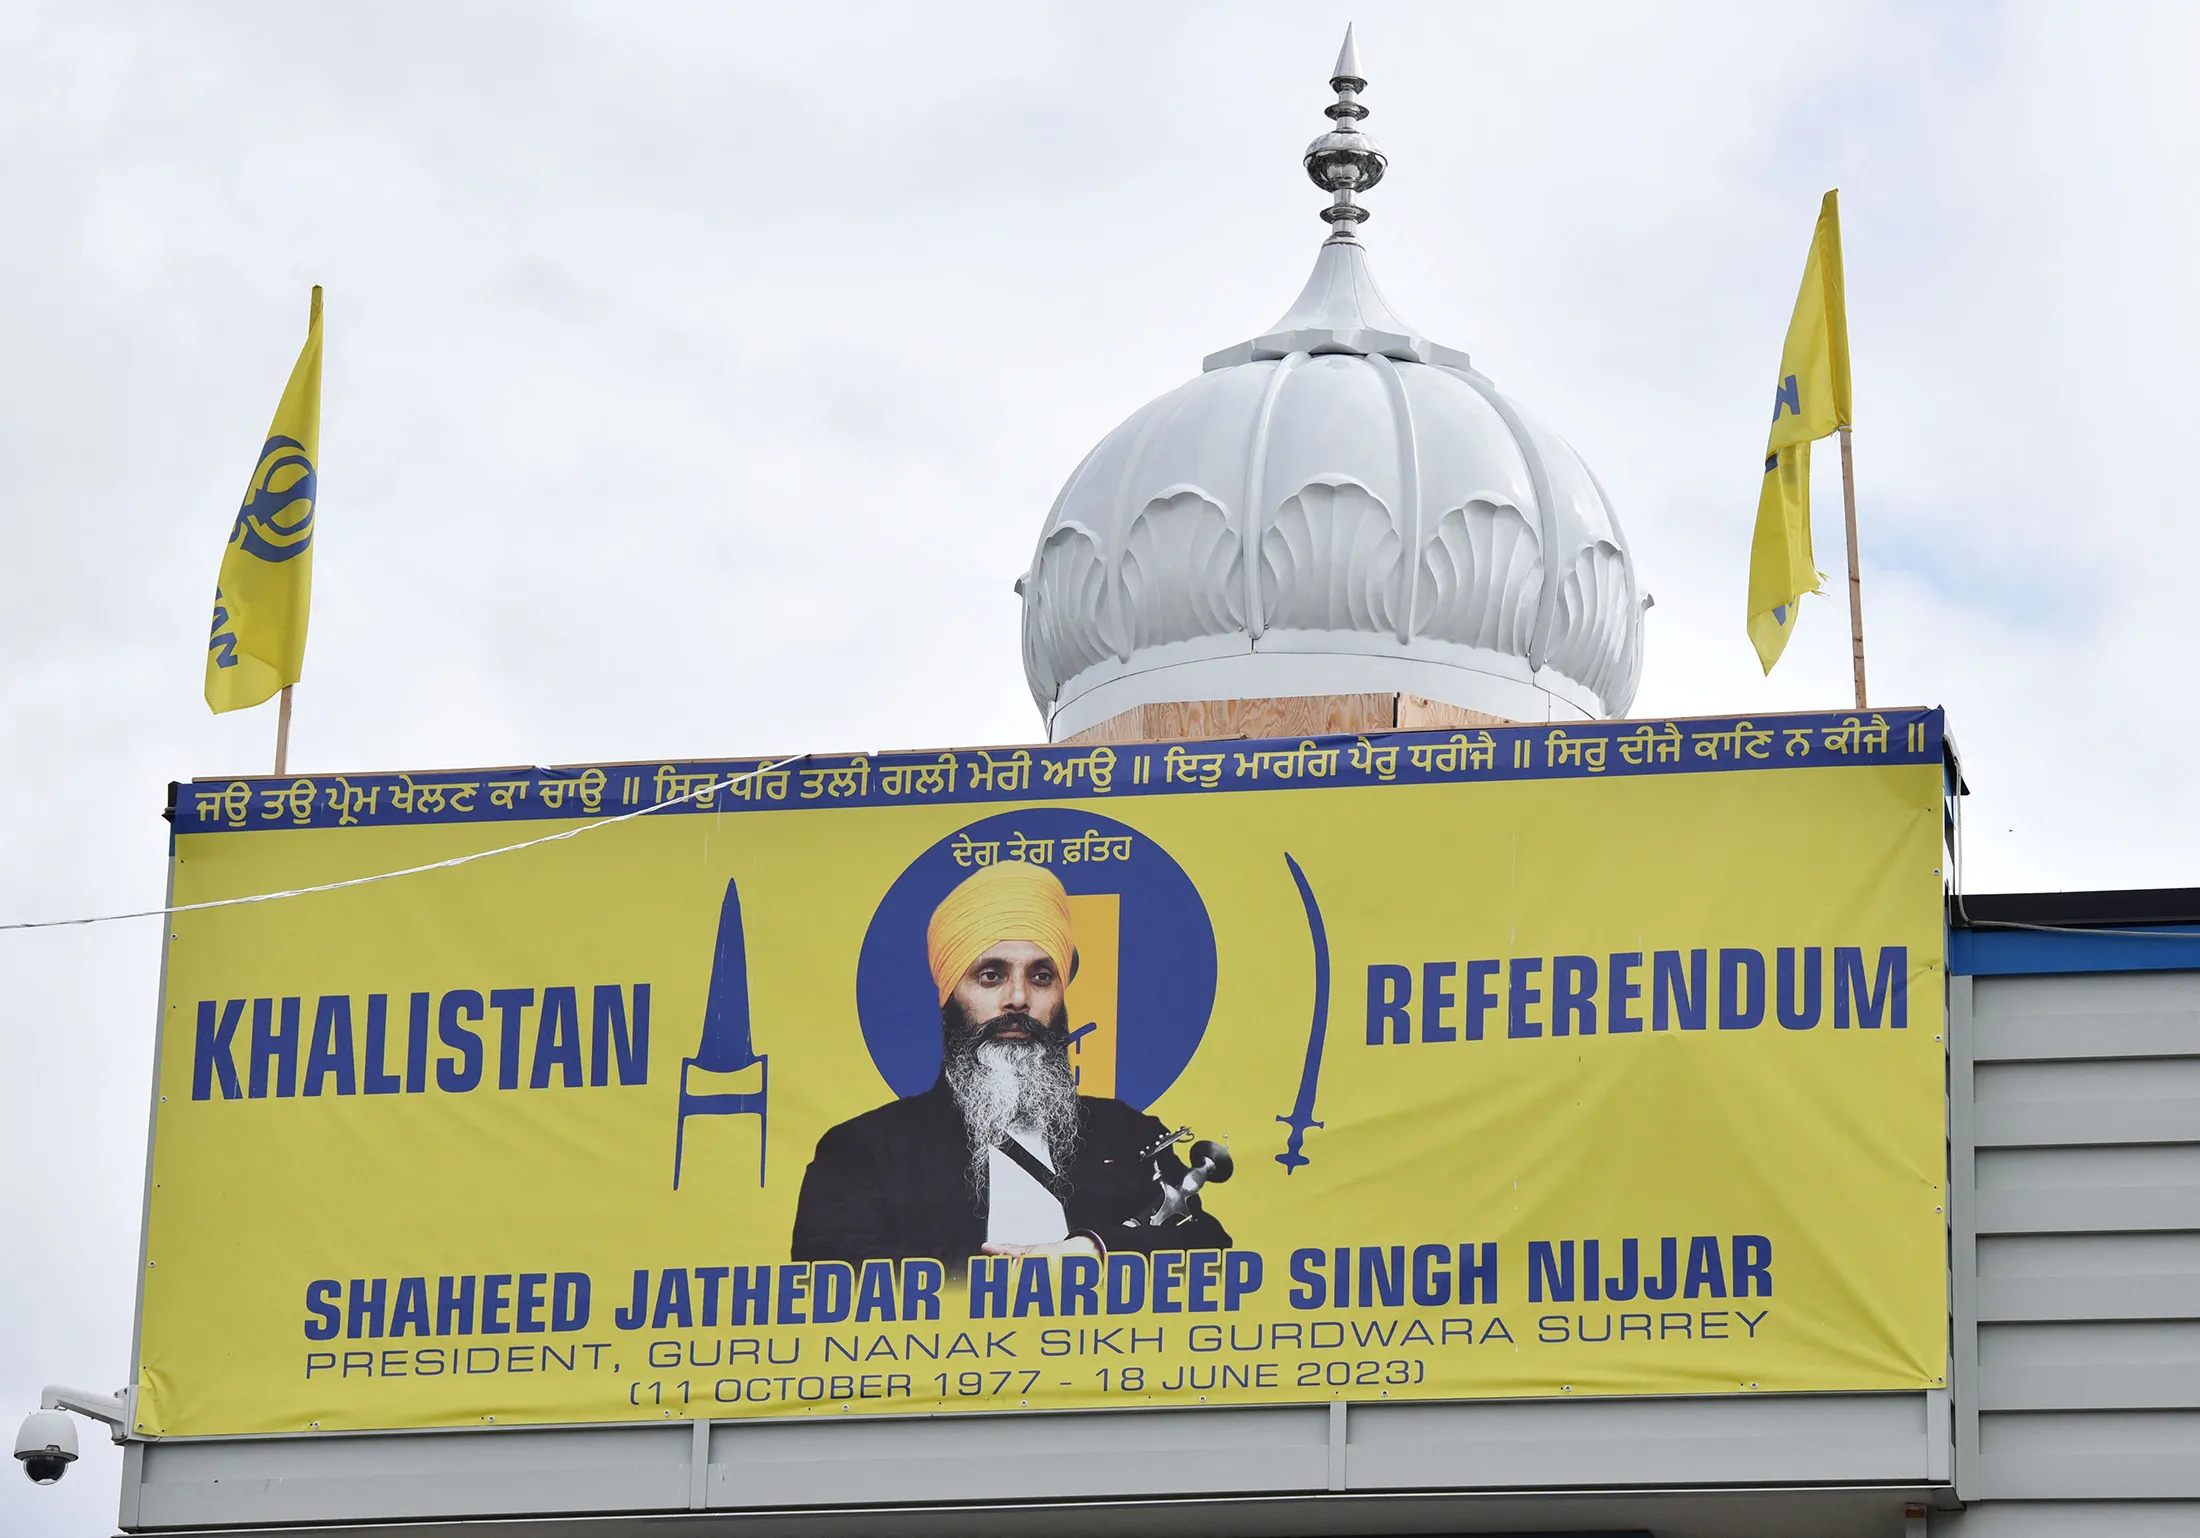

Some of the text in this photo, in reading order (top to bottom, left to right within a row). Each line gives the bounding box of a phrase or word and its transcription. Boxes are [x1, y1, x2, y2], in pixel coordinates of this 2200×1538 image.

[195, 781, 253, 827] ਜਉ
[259, 778, 316, 824] ਤਉ
[325, 776, 380, 826] ਪ੍ਰੇਮ
[390, 774, 478, 813] ਖੇਲਣ
[489, 782, 529, 808] ਕਾ
[540, 768, 606, 812] ਚਾਉ
[800, 756, 870, 798] ਤਲੀ
[880, 754, 958, 794] ਗਲੀ
[968, 750, 1031, 790] ਮੇਰੀ
[1042, 746, 1117, 793] ਆਉ
[1165, 747, 1225, 787] ਇਤੁ
[1235, 741, 1339, 778] ਮਾਰਗਿ
[1350, 736, 1399, 780] ਪੈਰੁ
[1407, 731, 1497, 772] ਧਰੀਜੈ
[1546, 730, 1608, 772] ਸਿਰੁ
[1618, 722, 1682, 764] ਦੀਜੈ
[1693, 722, 1774, 760] ਕਾਣਿ
[1784, 730, 1812, 756] ਨ
[1823, 715, 1889, 753] ਕੀਜੈ
[952, 834, 1000, 868] ਦੇਗ
[1005, 832, 1054, 864] ਤੇਗ
[192, 983, 651, 1101] KHALISTAN
[1366, 946, 1908, 1046] REFERENDUM
[304, 1235, 1772, 1341] SHAHEED JATHEDAR HARDEEP SINGH NIJJAR
[306, 1311, 1768, 1379] PRESIDENT, GURU NANAK SIKH GURDWARA SURREY
[630, 1380, 689, 1405] (11
[715, 1374, 911, 1402] OCTOBER
[935, 1370, 1040, 1396] 1977
[1098, 1367, 1144, 1391] 18
[1162, 1364, 1277, 1390] JUNE
[1298, 1360, 1424, 1386] 2023)
